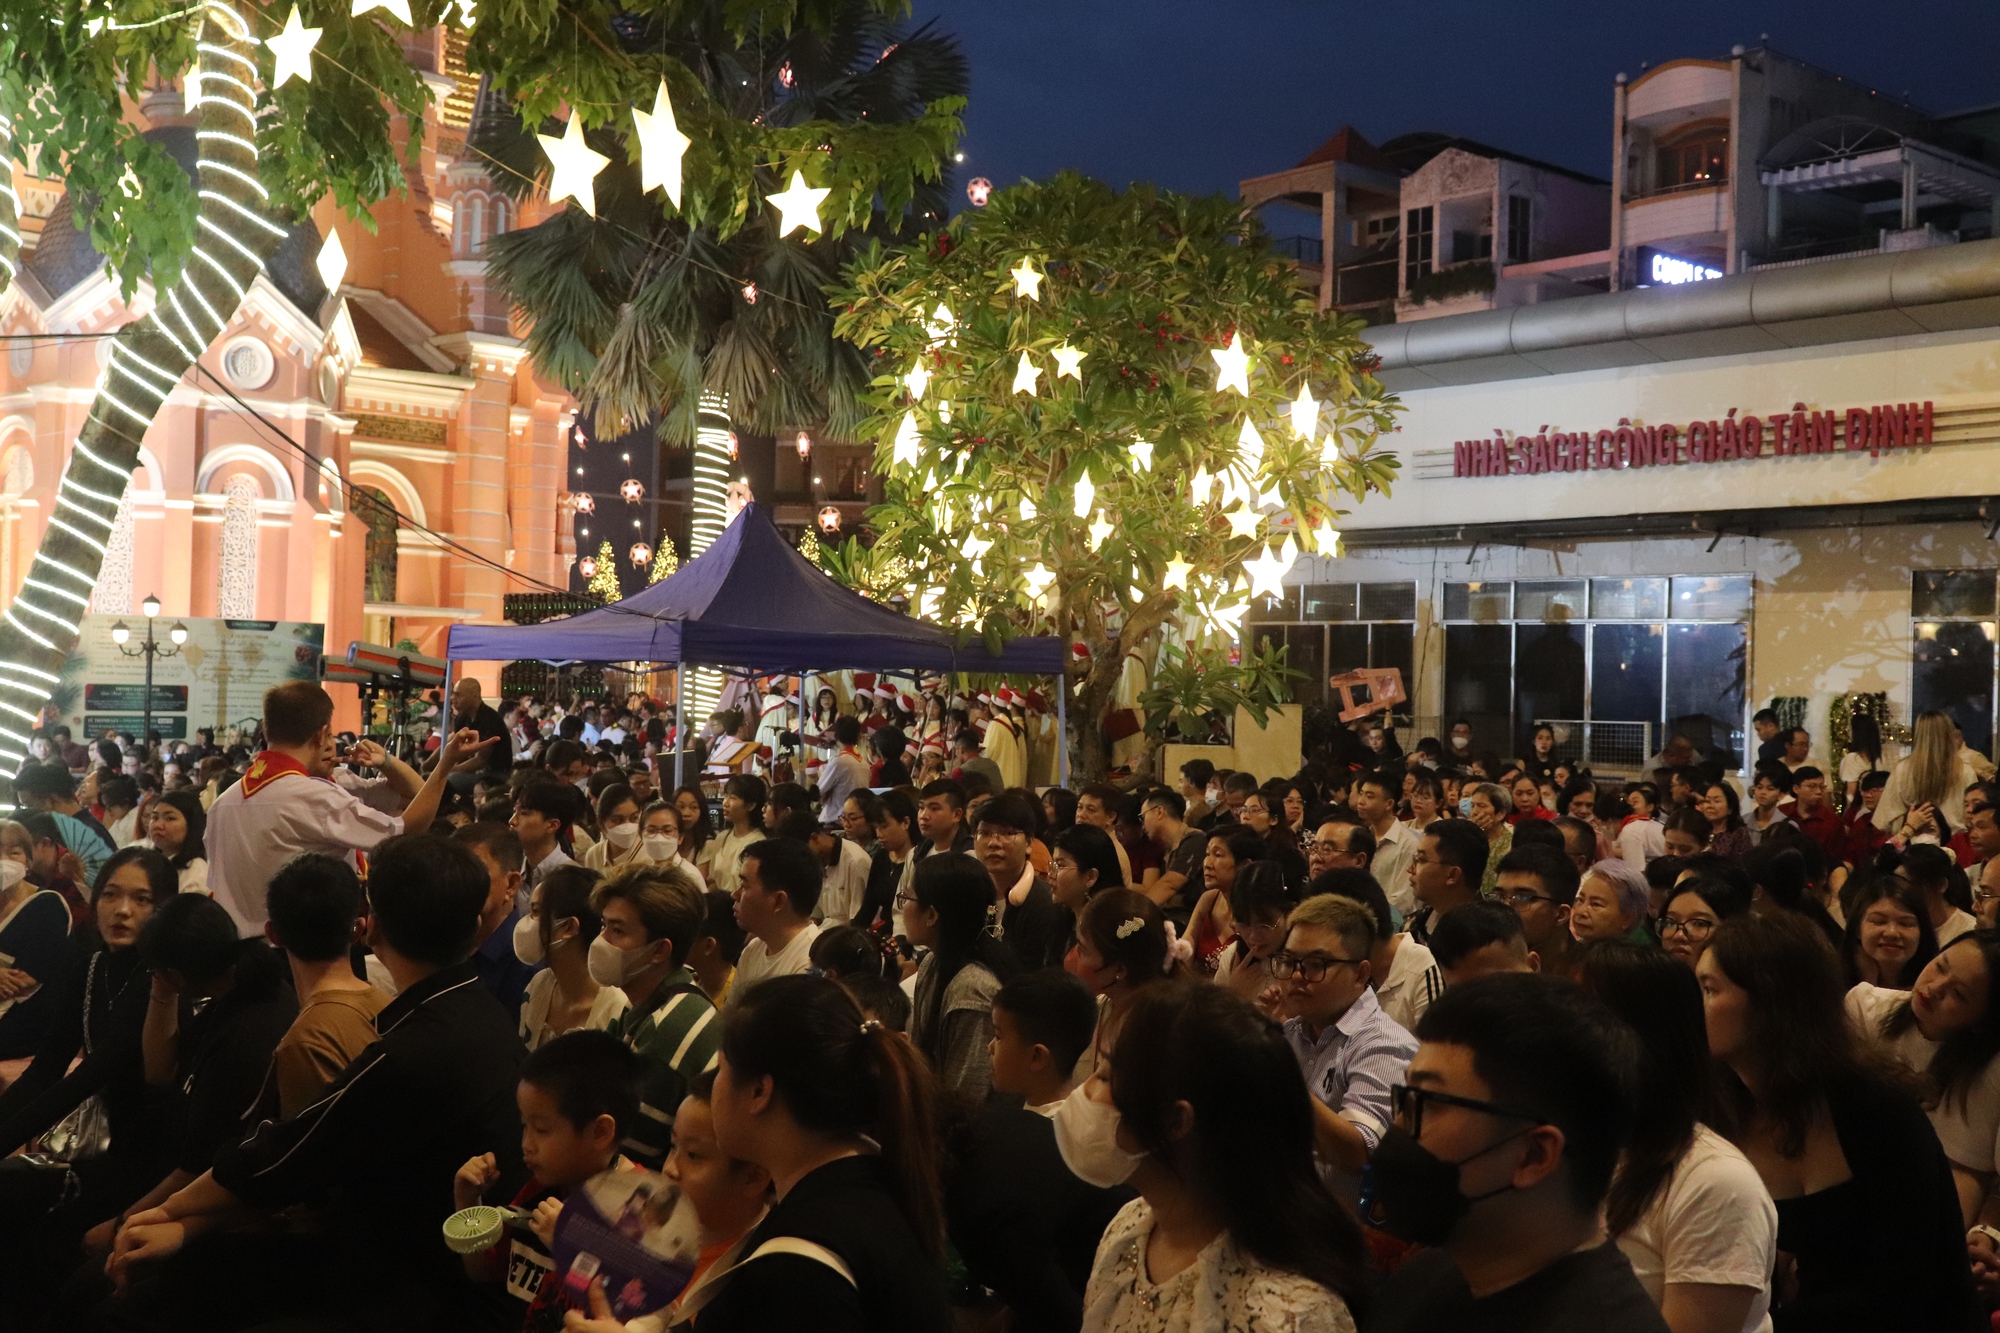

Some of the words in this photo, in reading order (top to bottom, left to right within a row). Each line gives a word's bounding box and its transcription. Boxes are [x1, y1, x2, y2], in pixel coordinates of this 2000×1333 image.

[1454, 428, 1509, 477] NHÀ
[1513, 425, 1590, 475] SÁCH
[1594, 418, 1678, 470] CÔNG
[1686, 407, 1762, 463] GIÁO
[1768, 402, 1835, 456] TÂN
[1845, 400, 1934, 458] ĐỊNH
